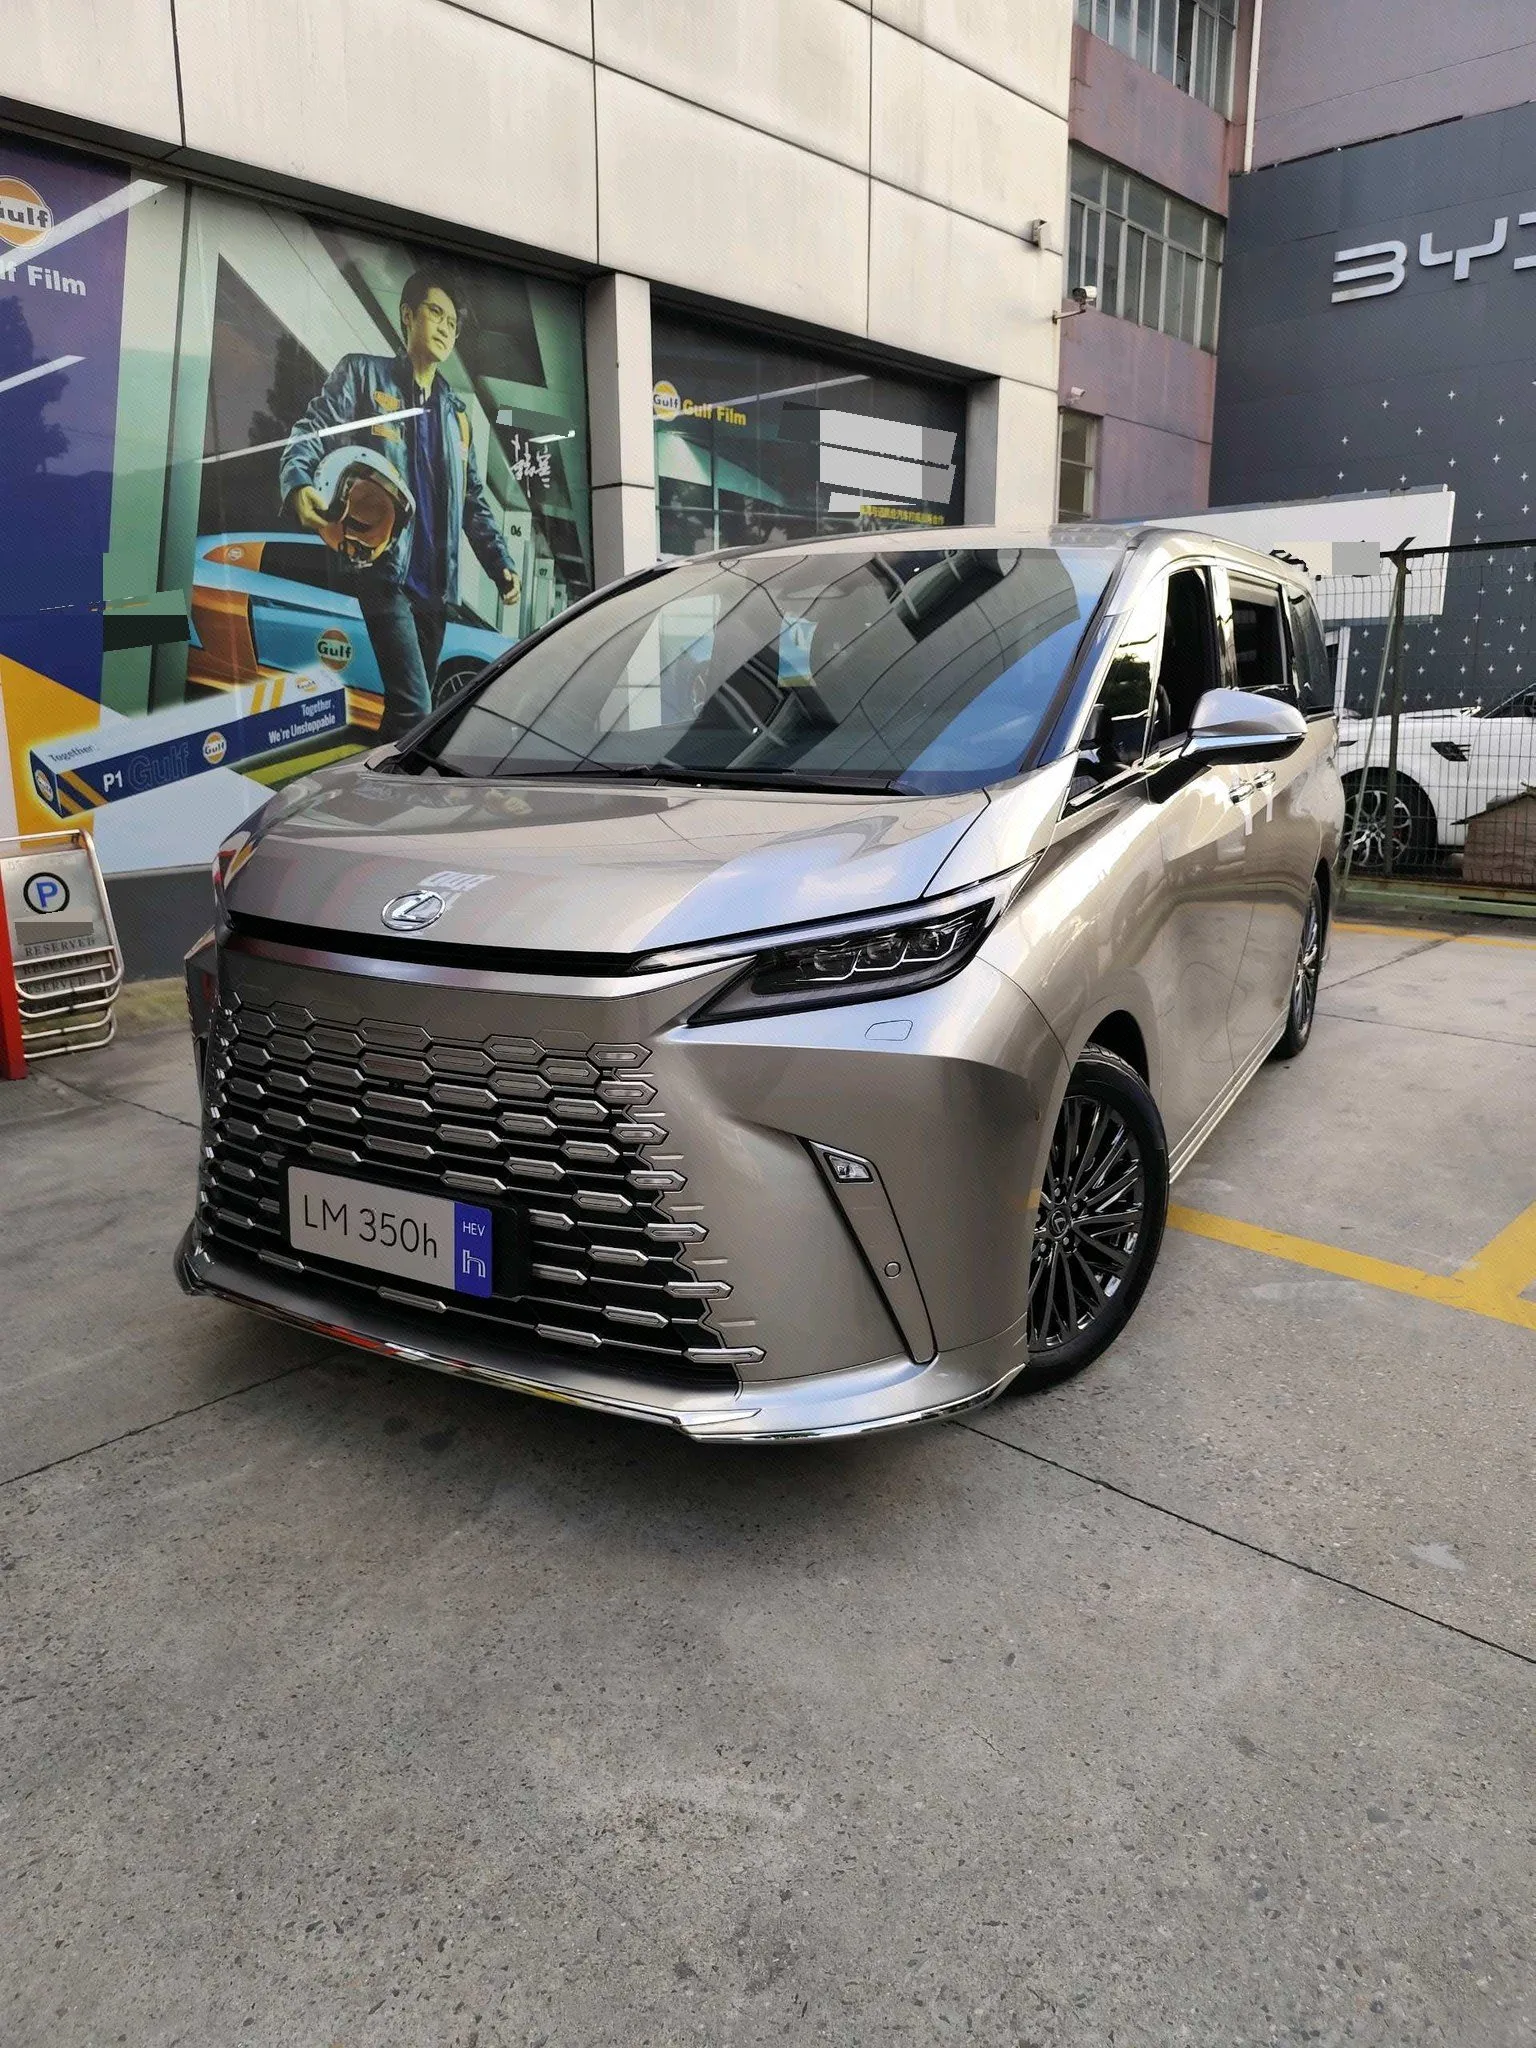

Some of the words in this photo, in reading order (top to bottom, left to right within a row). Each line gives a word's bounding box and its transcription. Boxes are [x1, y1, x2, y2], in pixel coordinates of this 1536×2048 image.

[27, 264, 87, 297] Film
[653, 394, 679, 409] Gulf
[682, 398, 713, 420] Gulf
[717, 406, 747, 426] Film
[510, 525, 522, 537] 06
[317, 641, 352, 659] Gulf
[268, 727, 291, 744] We're
[290, 713, 336, 738] Unstoppable
[204, 741, 225, 755] Gulf
[103, 769, 123, 793] P1
[128, 741, 190, 791] Gulf
[36, 881, 59, 908] P
[24, 934, 96, 958] RESERVED
[303, 1194, 348, 1236] LM
[358, 1207, 438, 1259] 350h
[462, 1220, 486, 1237] HEV
[462, 1249, 487, 1279] h
